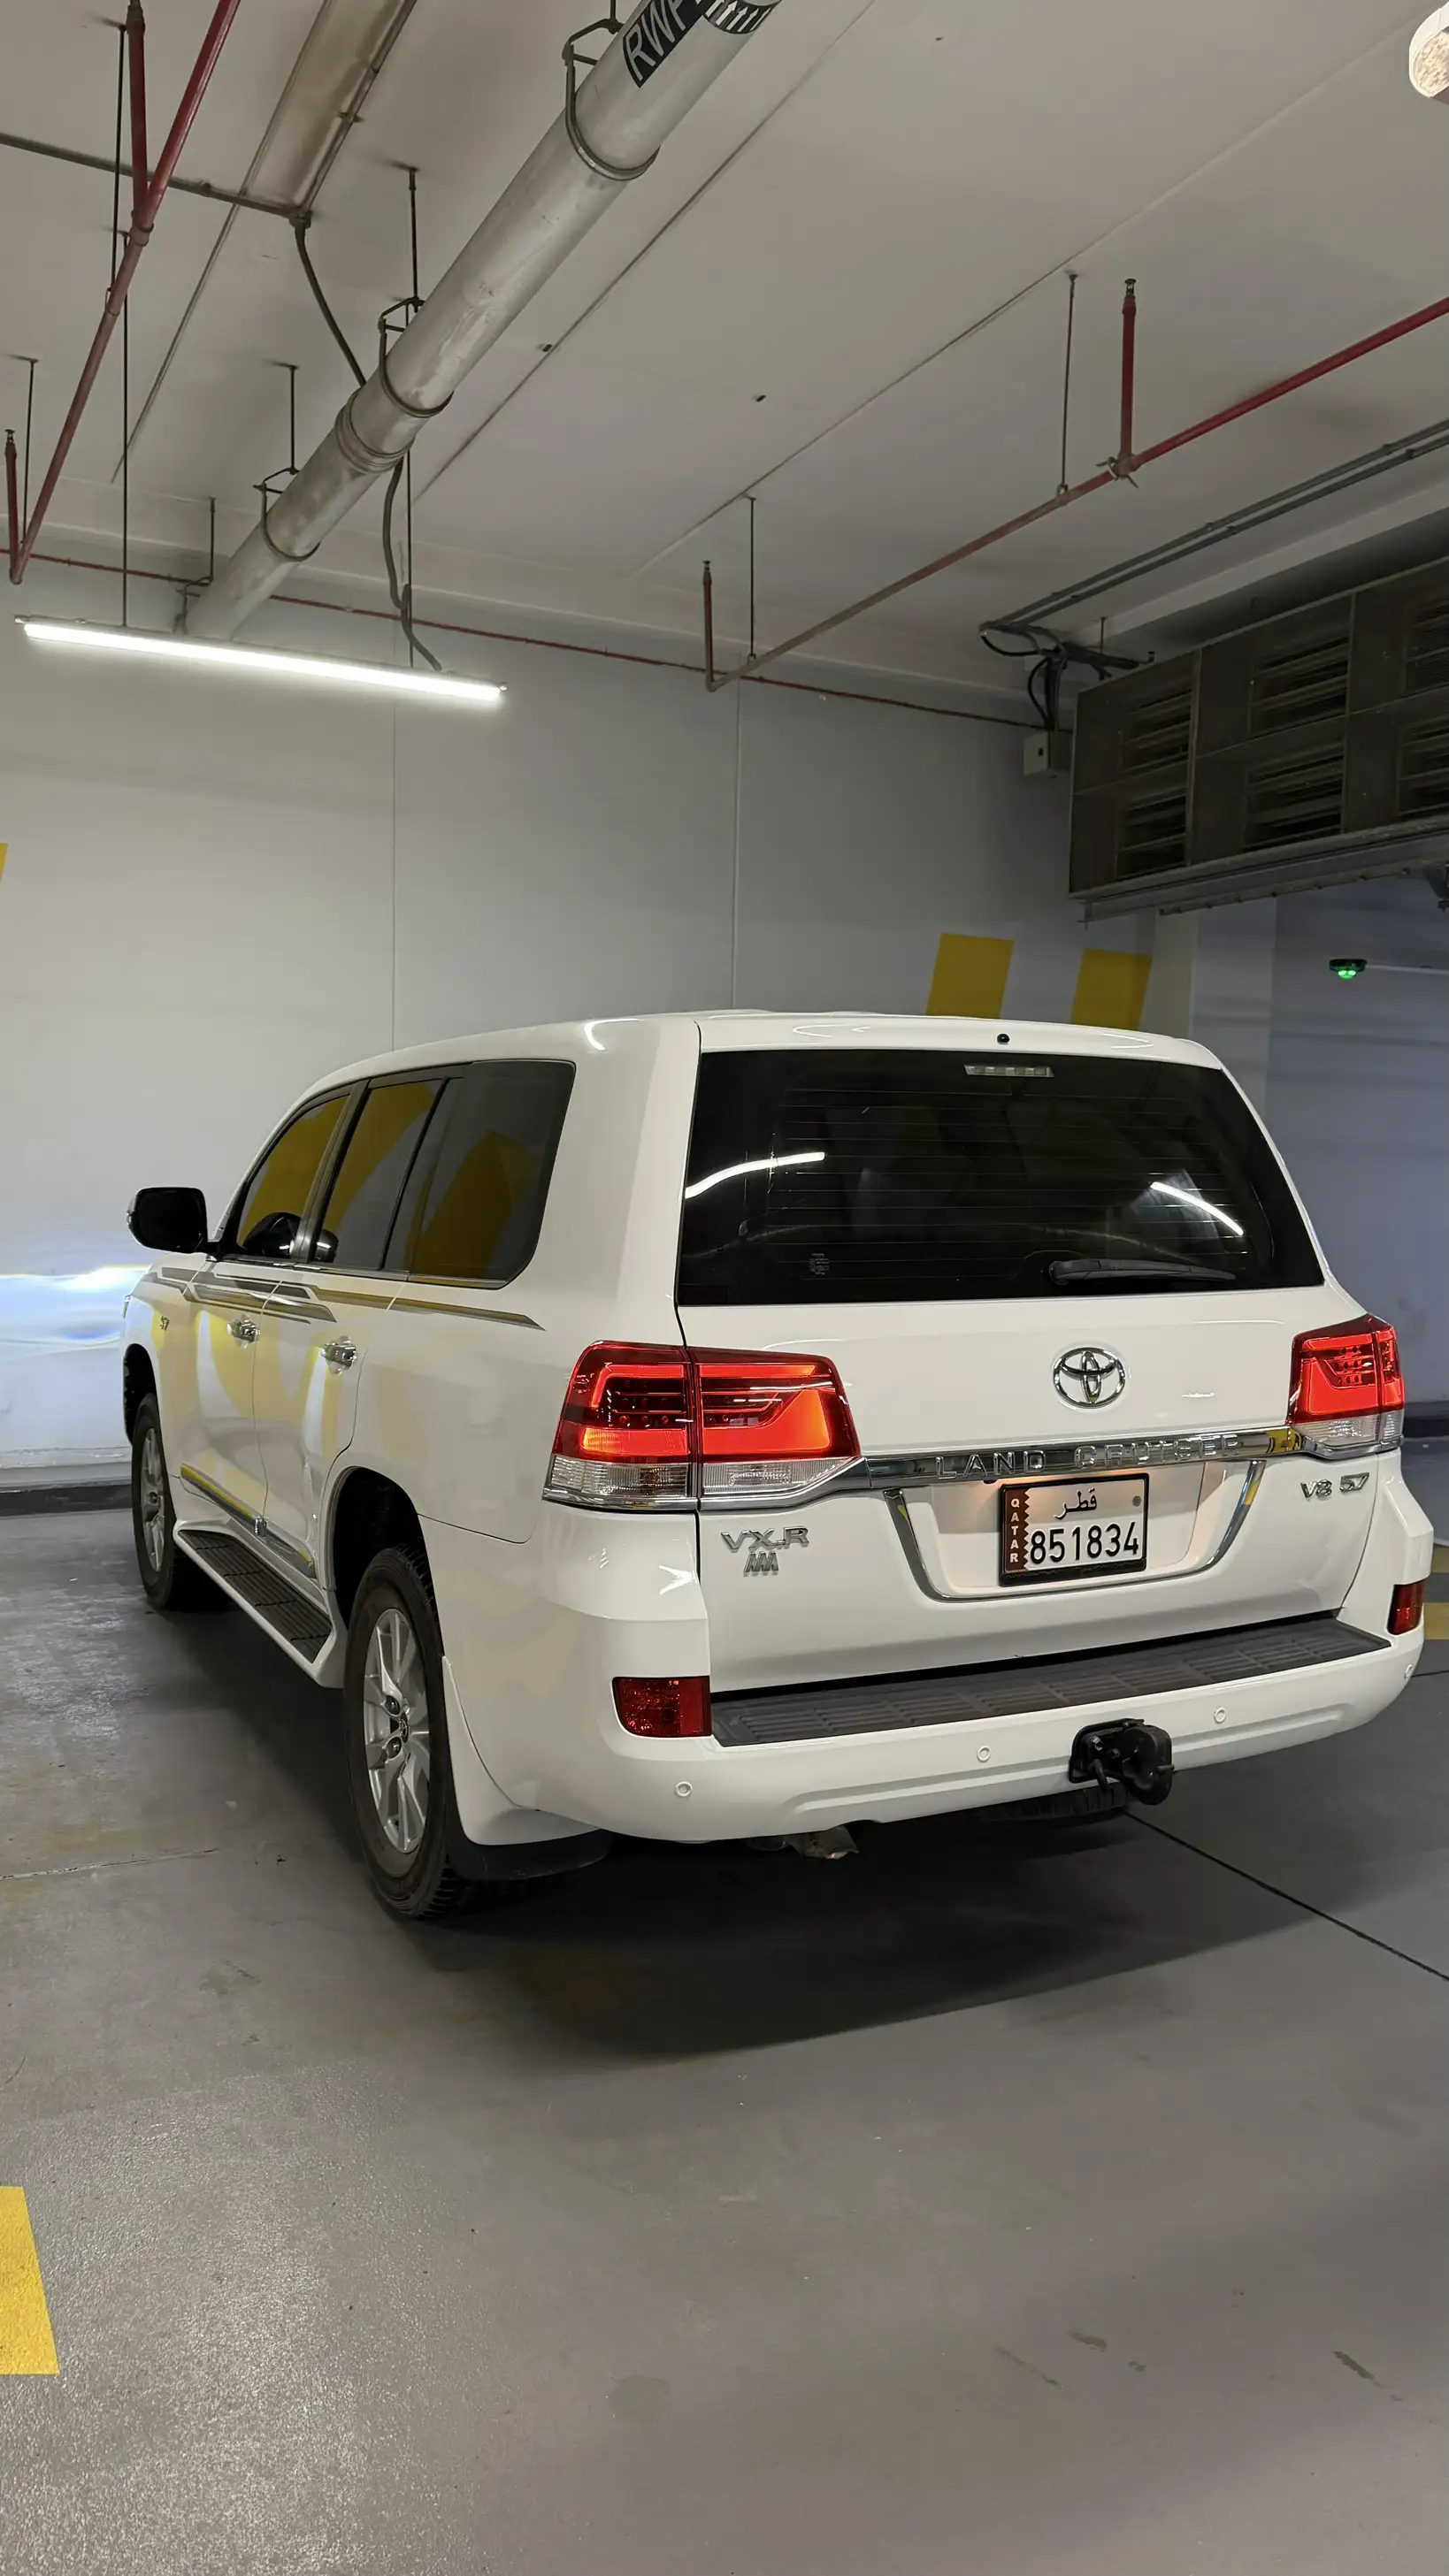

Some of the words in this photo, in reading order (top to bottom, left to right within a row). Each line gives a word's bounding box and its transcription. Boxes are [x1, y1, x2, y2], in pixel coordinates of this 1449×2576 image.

[935, 1450, 1046, 1480] LAND
[1074, 1433, 1244, 1469] CRUISER
[1054, 1487, 1098, 1520] قطر
[1300, 1479, 1332, 1499] V8
[1009, 1497, 1021, 1563] QATAR
[1030, 1521, 1139, 1564] 851834
